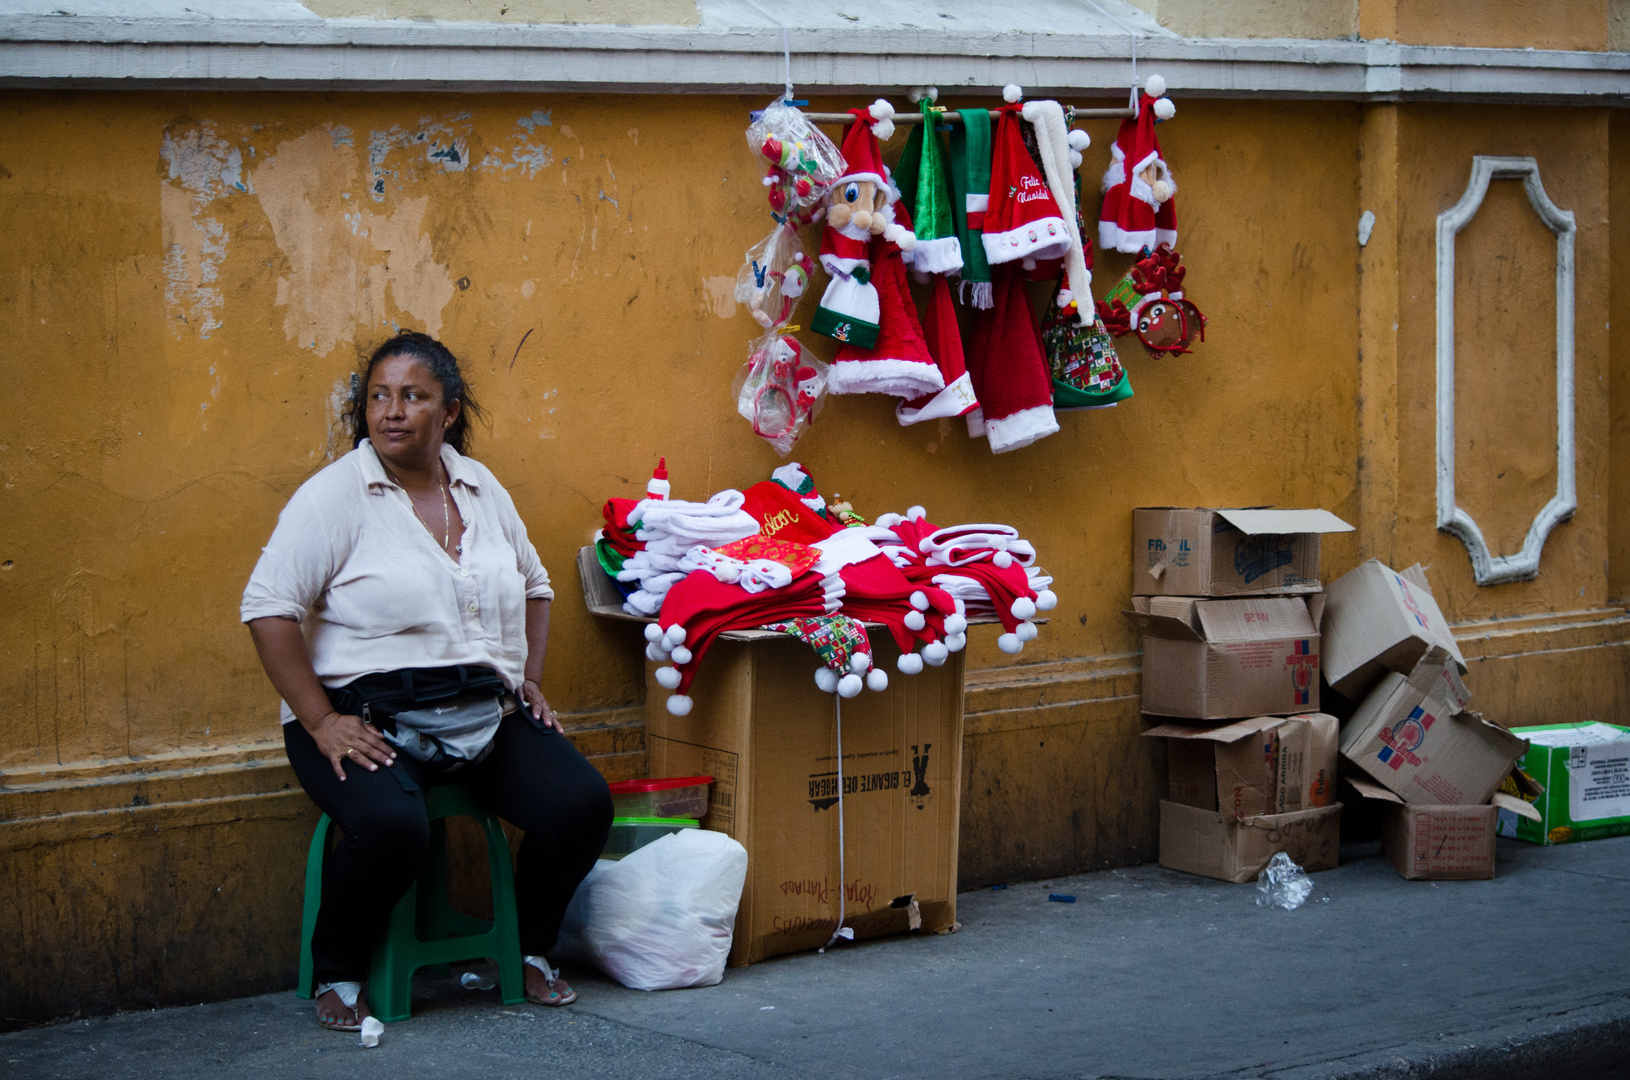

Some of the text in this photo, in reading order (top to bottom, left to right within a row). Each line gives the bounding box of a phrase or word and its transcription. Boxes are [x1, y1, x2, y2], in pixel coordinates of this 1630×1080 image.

[1020, 175, 1041, 190] Feliz
[1017, 188, 1050, 204] Navidad
[1147, 538, 1191, 552] FRIL
[808, 777, 838, 798] HOGAR
[856, 771, 900, 793] GIGANTE
[901, 770, 912, 788] EL
